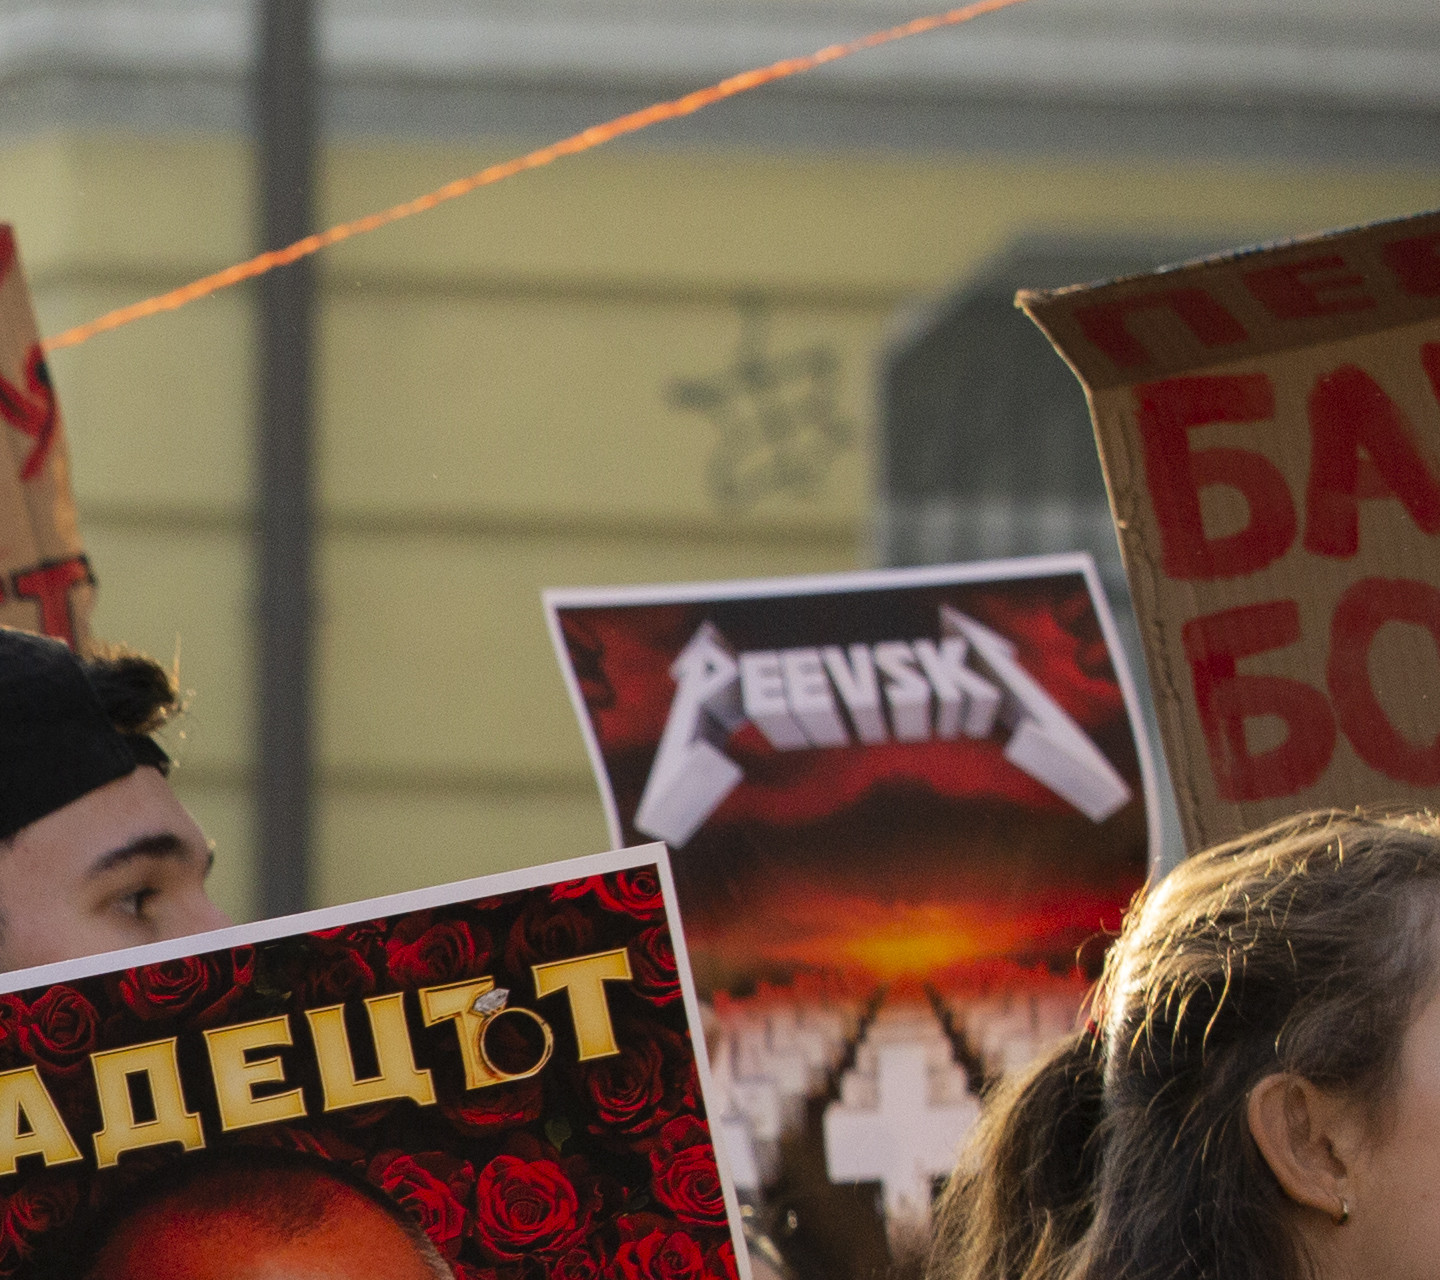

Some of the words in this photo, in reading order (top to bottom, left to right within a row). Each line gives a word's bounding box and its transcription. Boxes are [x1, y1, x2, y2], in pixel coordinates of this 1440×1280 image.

[1135, 340, 1440, 580] БА
[634, 603, 1132, 850] PEEVSKI
[1180, 576, 1440, 800] БО
